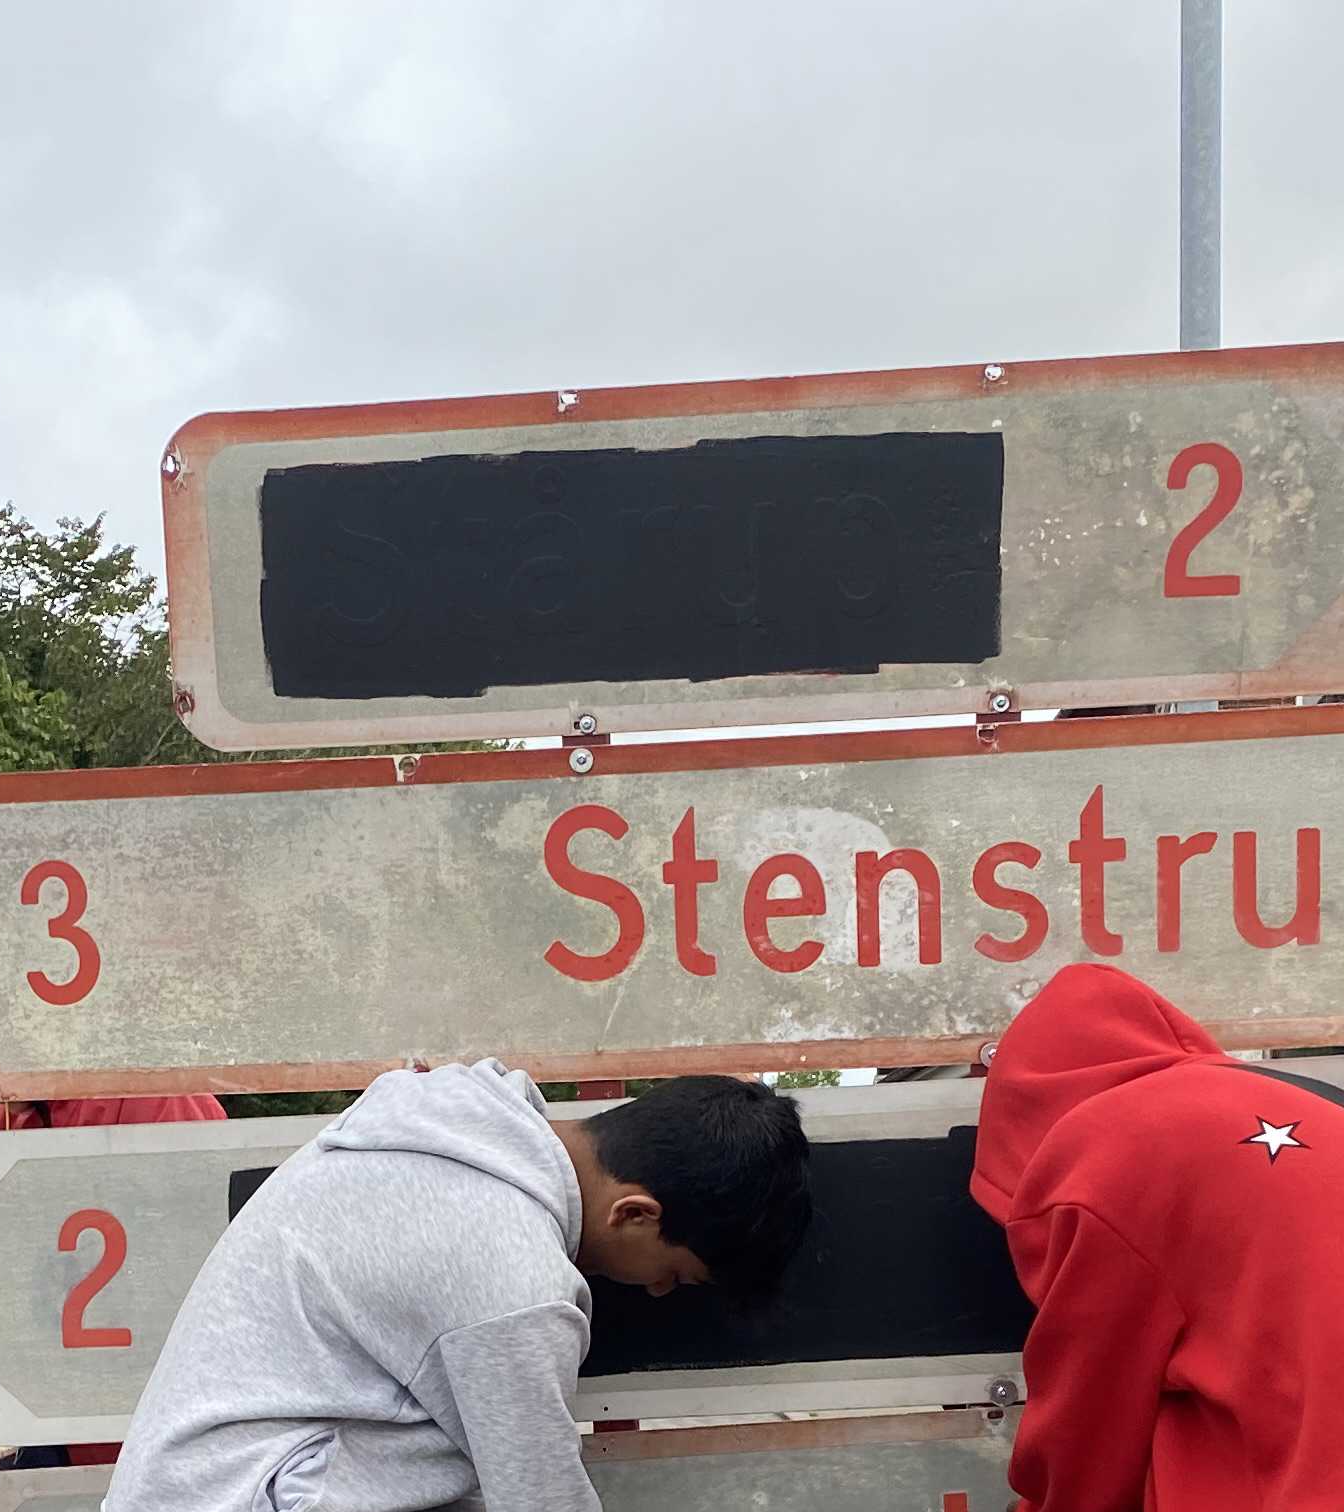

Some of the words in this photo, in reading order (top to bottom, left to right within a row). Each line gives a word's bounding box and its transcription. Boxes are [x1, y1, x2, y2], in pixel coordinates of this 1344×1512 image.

[1163, 442, 1245, 598] 2
[20, 860, 102, 1006] 3
[57, 1208, 133, 1349] 2
